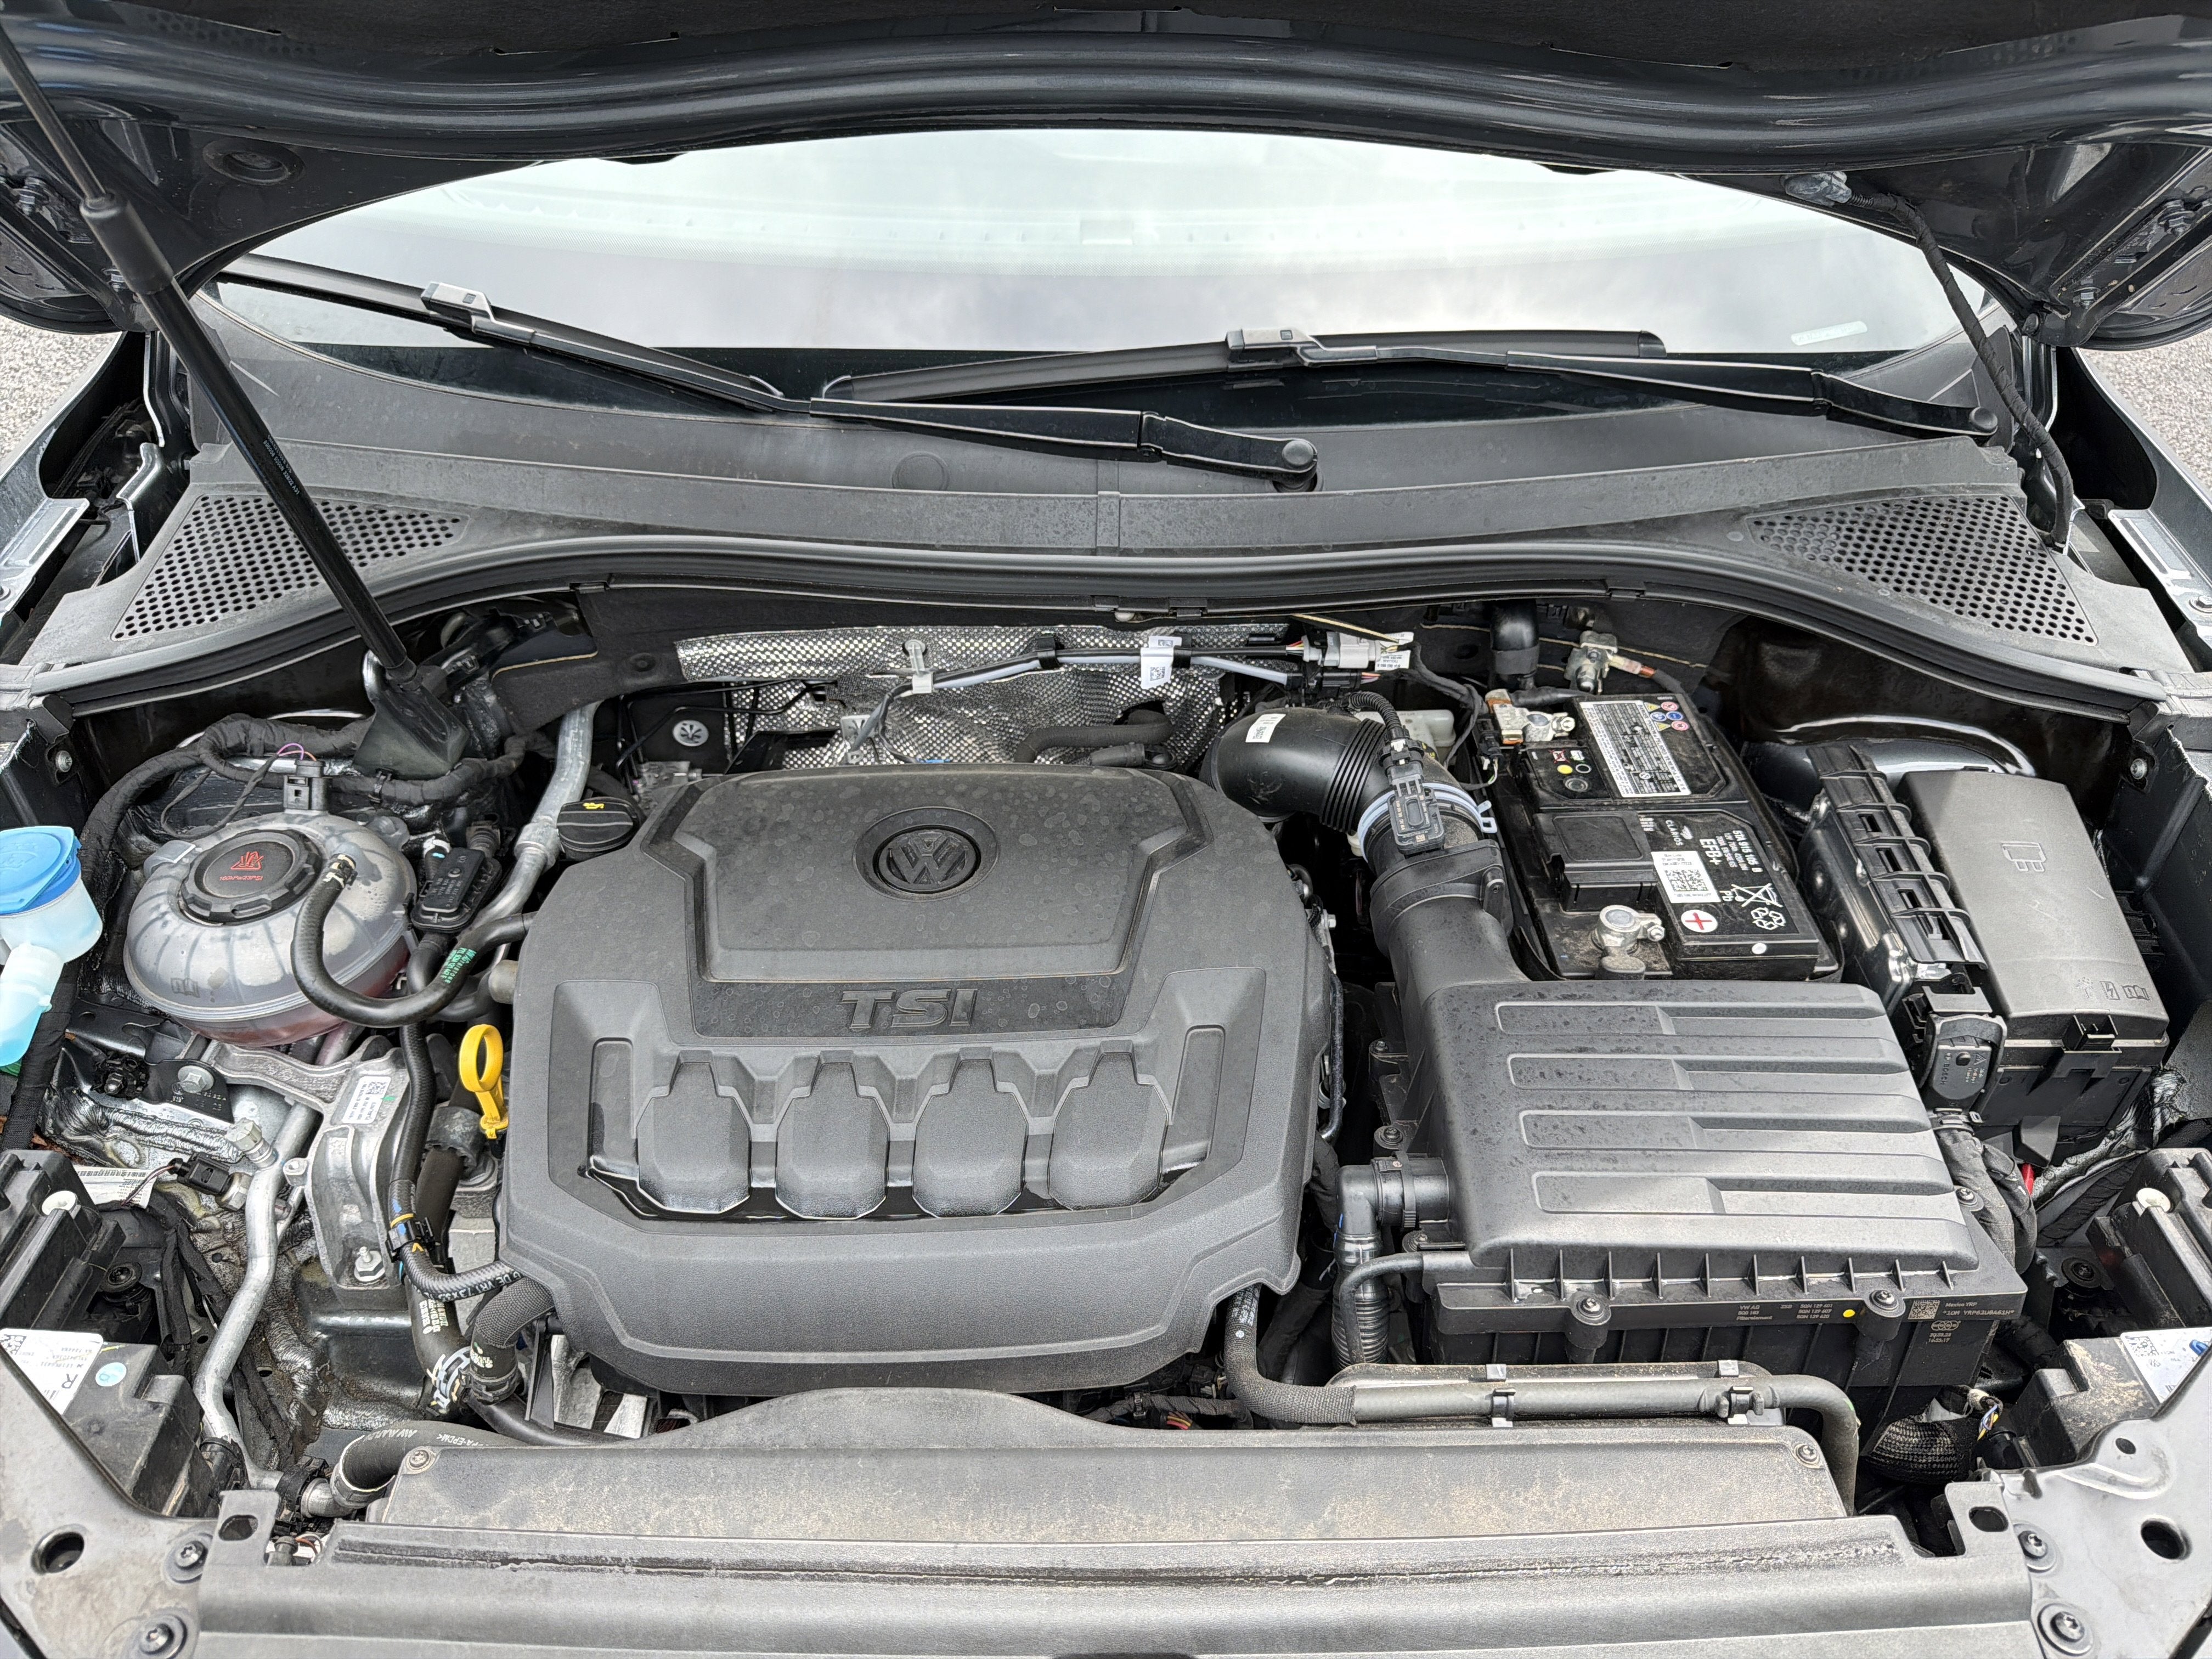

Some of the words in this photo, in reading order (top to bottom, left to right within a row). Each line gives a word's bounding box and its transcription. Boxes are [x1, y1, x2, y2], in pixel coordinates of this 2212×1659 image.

[1665, 820, 1684, 846] CLARIOS
[1700, 839, 1723, 865] EFB+
[1738, 841, 1753, 853] 915
[878, 827, 979, 892] VW
[1745, 854, 1759, 865] 105
[1719, 890, 1734, 901] Pb
[840, 988, 978, 1029] TSI
[1940, 1062, 1950, 1085] BOSCH
[61, 1373, 78, 1389] R
